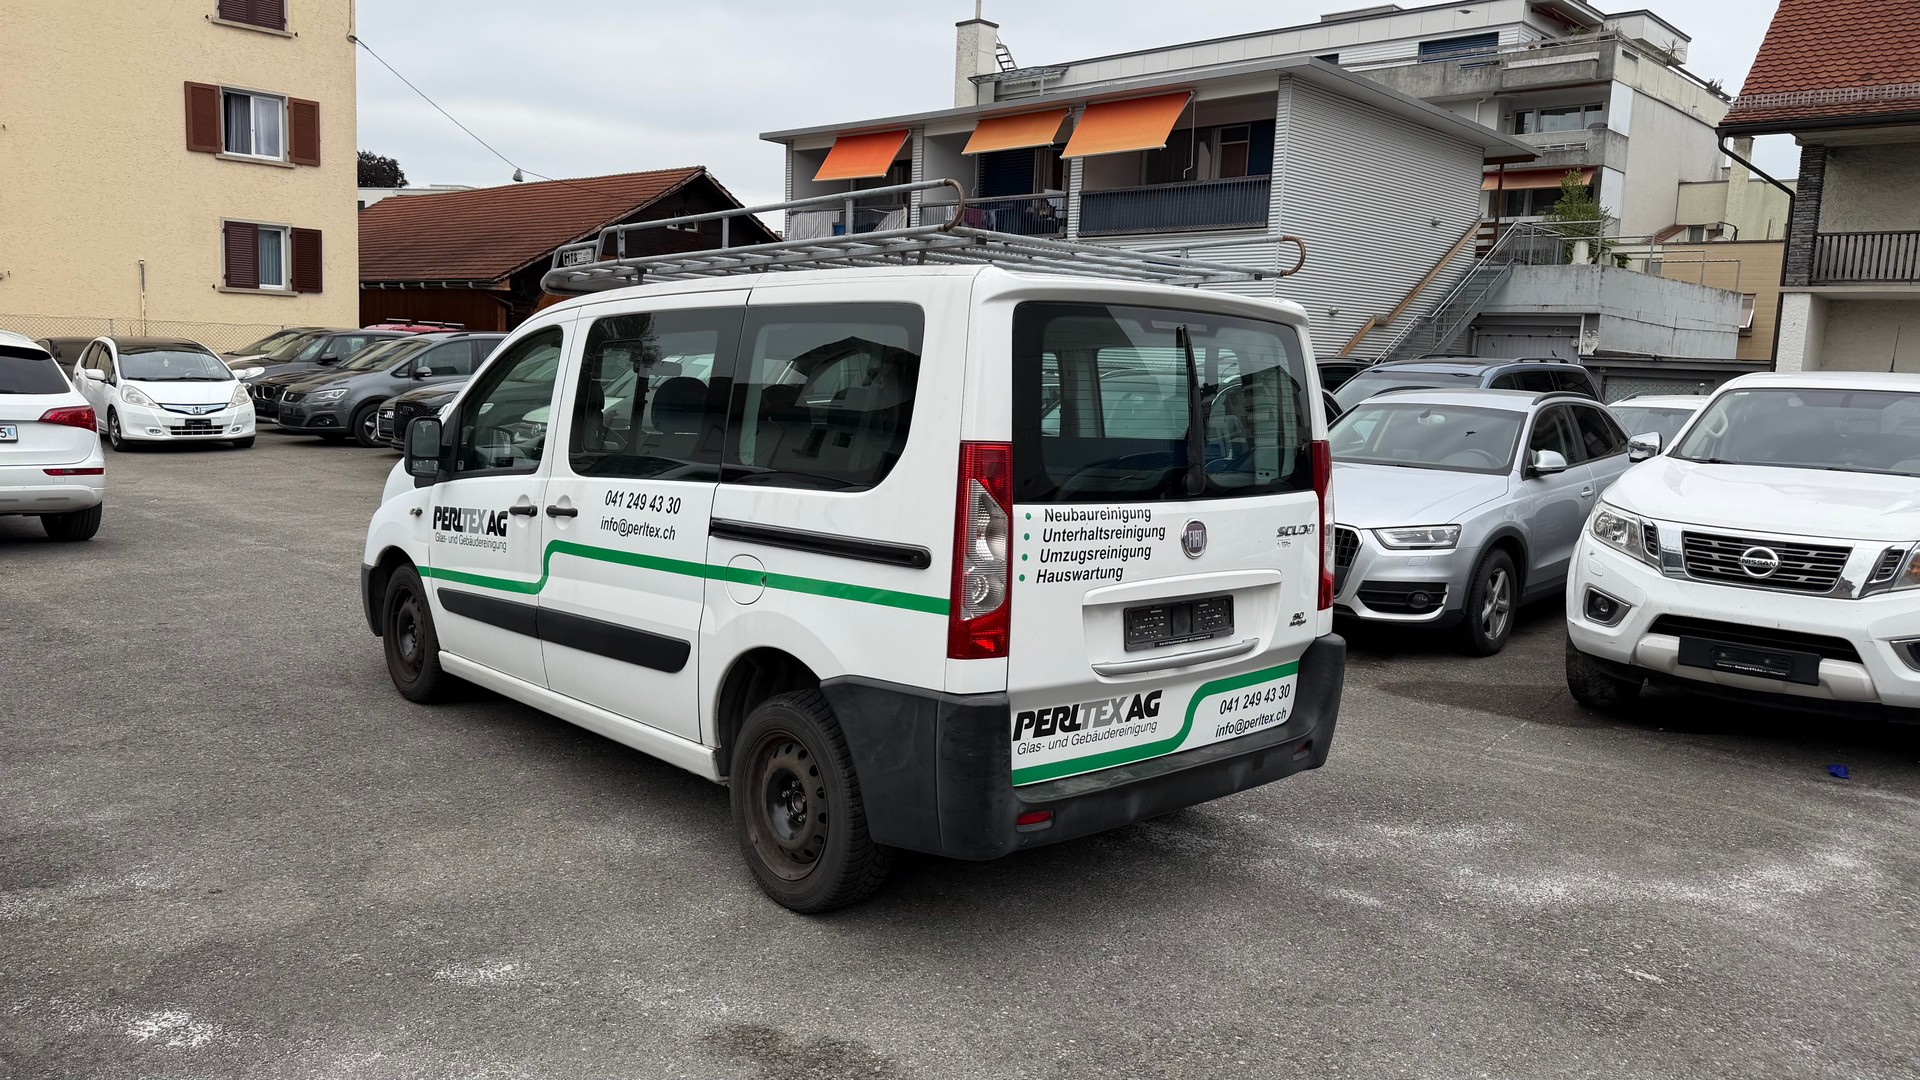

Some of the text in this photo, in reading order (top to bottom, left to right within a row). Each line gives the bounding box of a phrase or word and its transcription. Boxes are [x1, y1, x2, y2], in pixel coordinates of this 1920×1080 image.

[605, 490, 681, 514] 041 249 43 30
[1044, 507, 1151, 523] Neubaureinigung
[600, 516, 676, 540] info@perltex.ch
[1042, 525, 1166, 542] Unterhaltsreinigung
[435, 532, 507, 553] Glas- und Gebäudereinigung
[1188, 529, 1203, 548] FIAT
[1039, 545, 1152, 564] Umzugsreinigung
[1741, 558, 1777, 567] NISSAN
[1036, 566, 1124, 584] Hauswartung
[1219, 683, 1291, 715] 041 249 43 30
[1215, 707, 1287, 738] info@perltex.ch
[1017, 720, 1158, 755] Glas- und Gebäudereinigung
